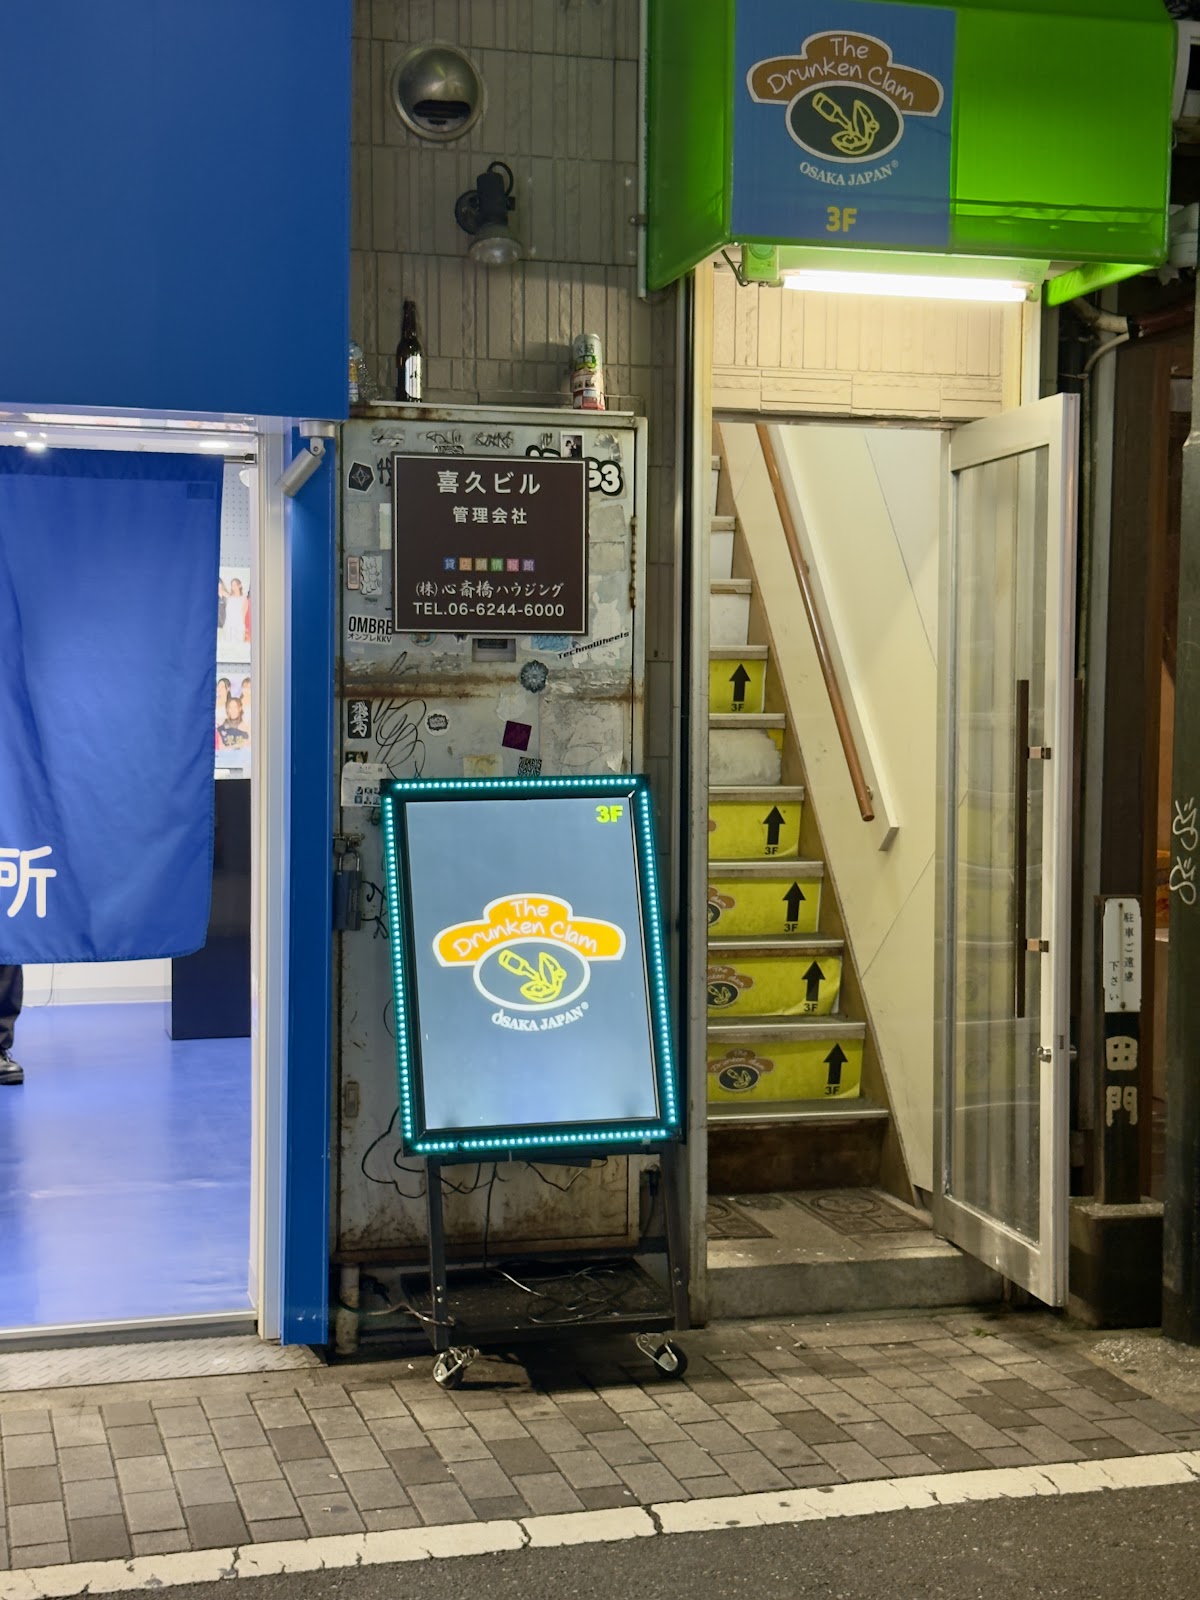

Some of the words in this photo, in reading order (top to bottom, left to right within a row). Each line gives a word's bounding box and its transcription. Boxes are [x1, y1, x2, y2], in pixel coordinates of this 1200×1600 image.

[830, 37, 869, 59] The
[767, 57, 862, 95] Drunken
[868, 66, 914, 107] Clam
[799, 161, 846, 186] OSAKA
[826, 206, 857, 233] 3F
[436, 470, 541, 495] 喜久ビル
[452, 506, 528, 525] 管理会社
[412, 602, 566, 617] TEL.06-6244-6000
[348, 616, 392, 635] OMBRE
[731, 703, 744, 712] 3F
[595, 805, 624, 823] 3F
[764, 846, 778, 855] 3F
[510, 899, 549, 917] The
[784, 923, 798, 932] 3F
[452, 919, 546, 958] Drunken
[549, 921, 598, 953] Clam
[1108, 960, 1120, 1001] 下さい
[803, 1002, 818, 1012] 3F
[491, 1009, 540, 1032] OSAKA
[825, 1086, 840, 1095] 3F
